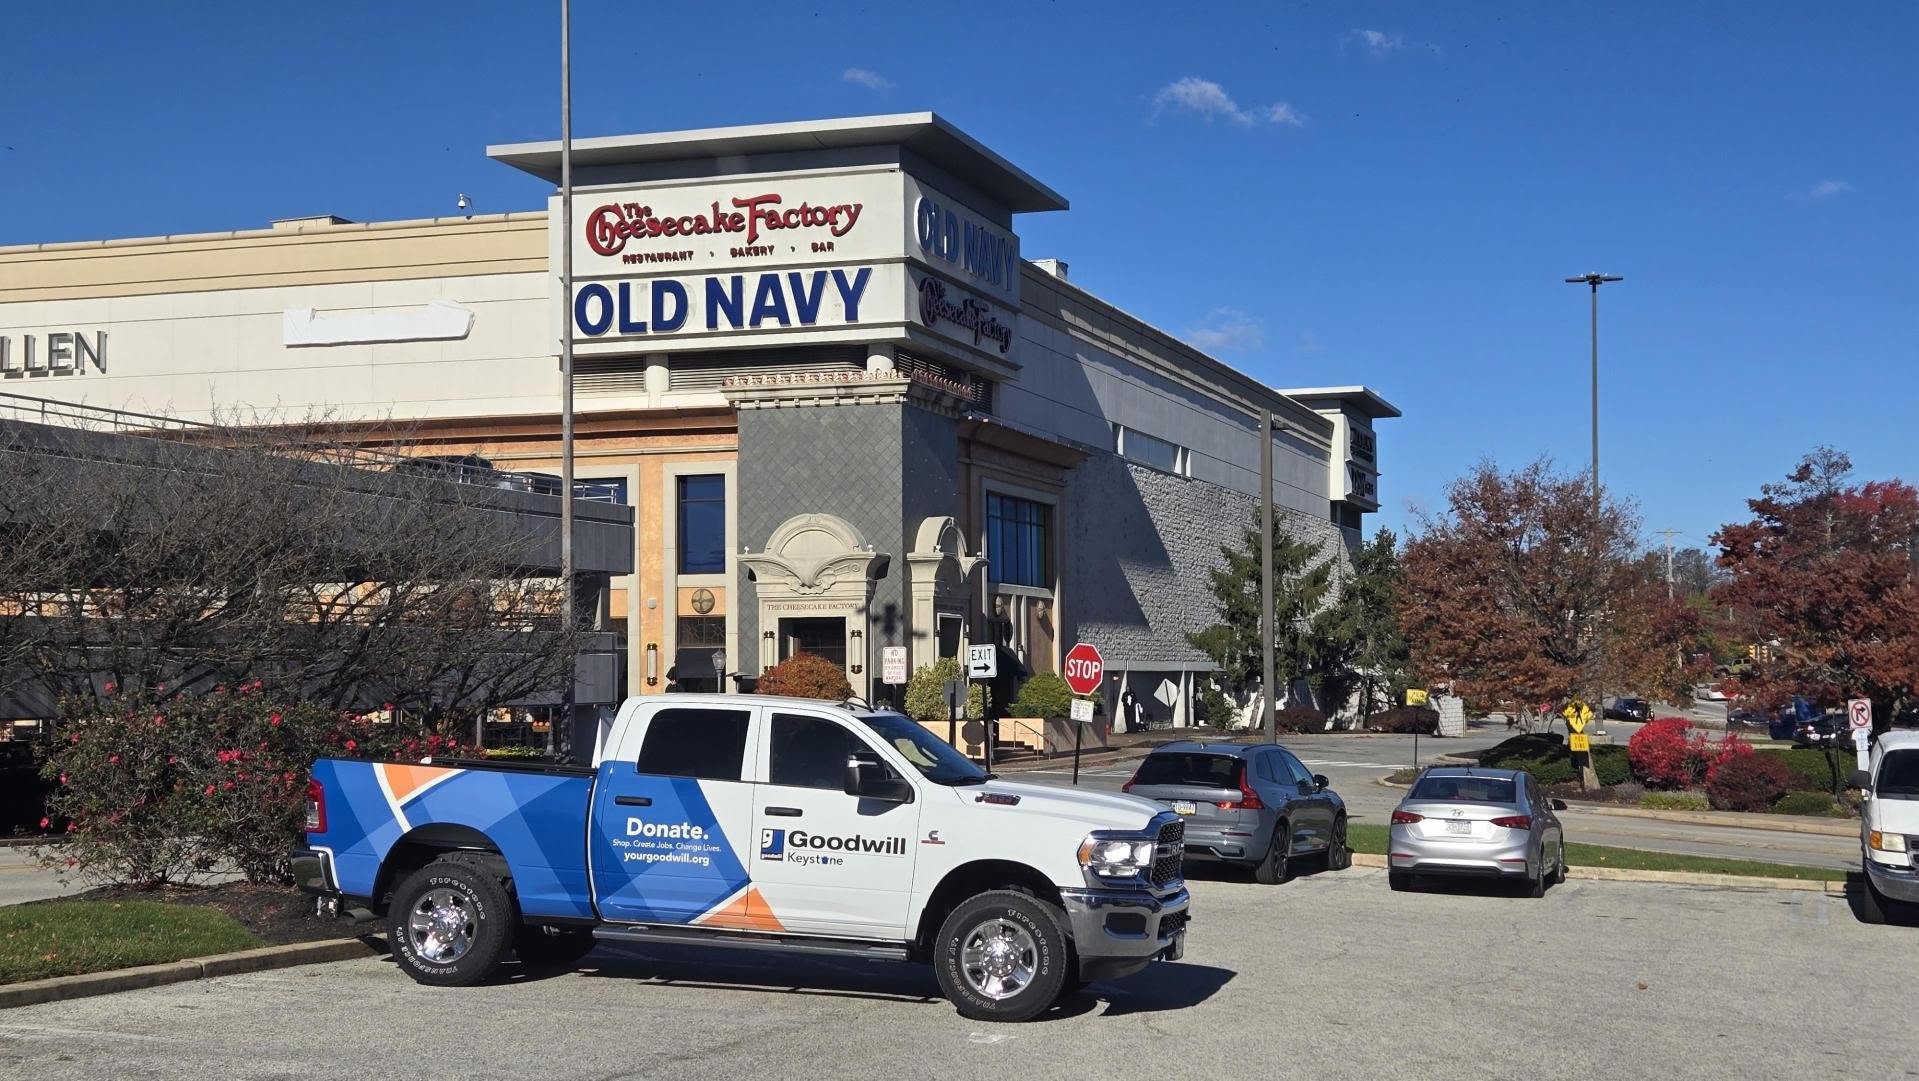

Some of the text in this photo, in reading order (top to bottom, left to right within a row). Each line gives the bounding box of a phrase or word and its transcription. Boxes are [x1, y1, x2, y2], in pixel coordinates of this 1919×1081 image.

[623, 203, 652, 219] The
[586, 193, 863, 257] Cheesecake Factory
[811, 241, 835, 253] BAR
[914, 196, 1016, 292] OLD NAVY
[574, 267, 873, 337] OLD NAVY
[767, 603, 782, 611] THE
[782, 602, 826, 610] CHEESECAKE
[971, 648, 992, 661] EXIT
[1067, 659, 1101, 680] STOP
[626, 817, 709, 840] Donate.
[612, 839, 632, 849] Shop.
[633, 840, 656, 848] Create
[656, 841, 674, 850] Jobs.
[703, 844, 722, 852] Lives.
[788, 830, 906, 855] Goodwill
[624, 851, 710, 867] yourgoodwill.org
